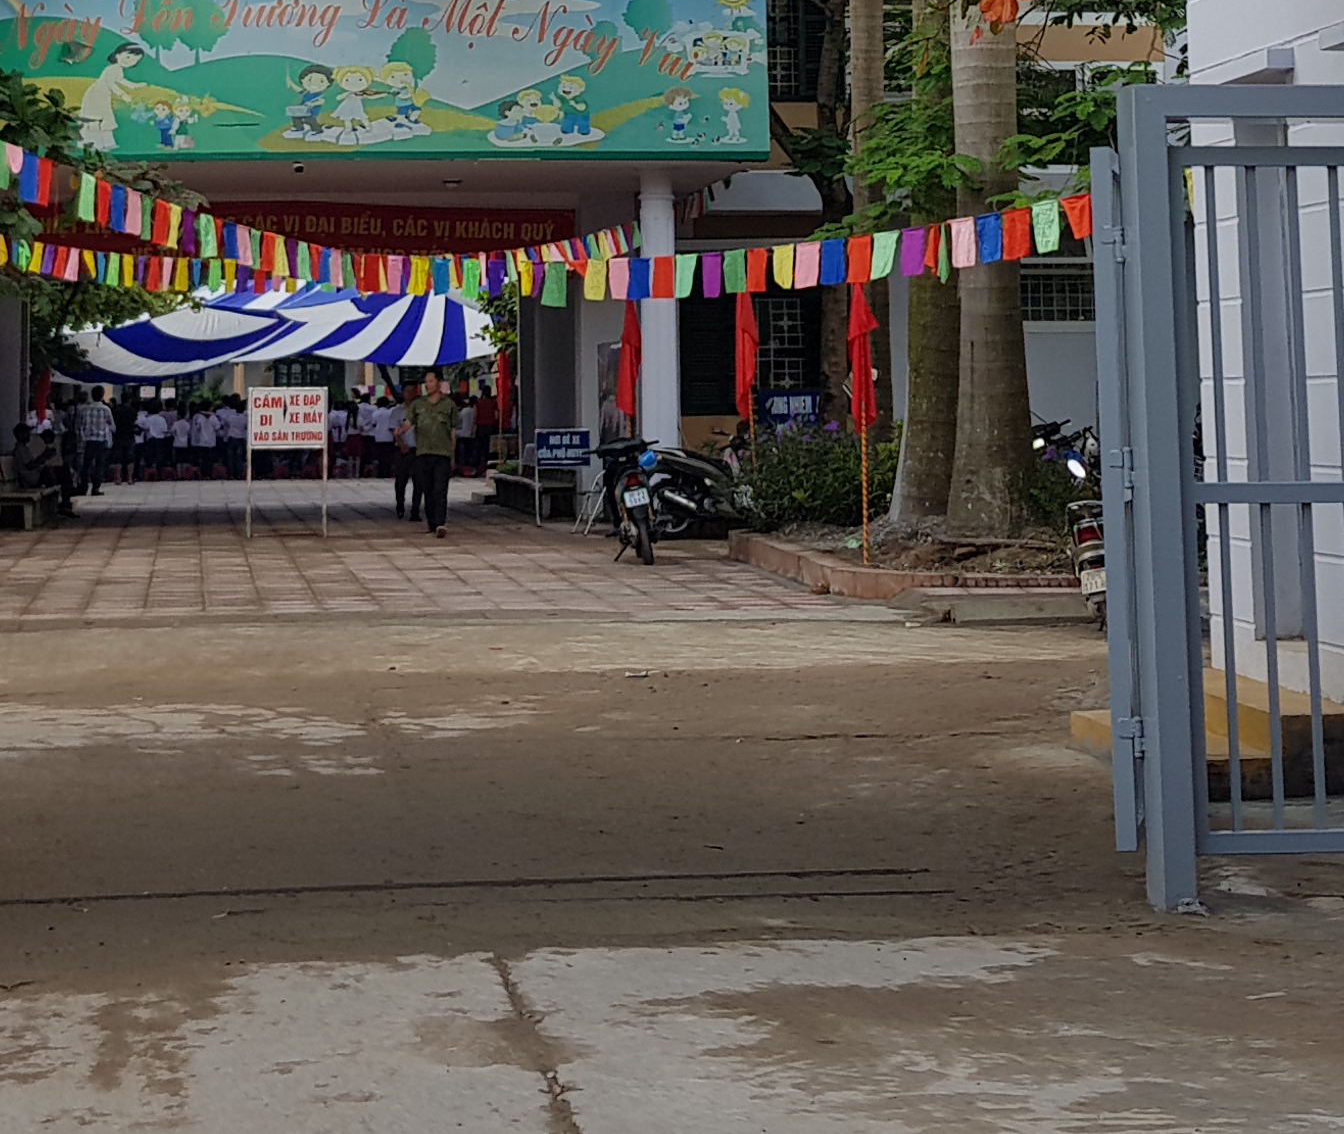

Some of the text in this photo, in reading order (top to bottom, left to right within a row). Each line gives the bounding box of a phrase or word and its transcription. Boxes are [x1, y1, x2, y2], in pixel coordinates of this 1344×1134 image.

[512, 1, 619, 75] Ngày
[637, 26, 701, 82] Vui
[284, 214, 300, 235] VỊ
[305, 215, 334, 235] ĐẠI
[340, 212, 386, 238] BIỂU,
[392, 215, 429, 237] CÁC
[434, 221, 449, 241] VỊ
[455, 218, 514, 240] KHÁCH
[521, 219, 556, 242] QUÝ
[254, 392, 321, 409] CẤM XE ĐẠP
[260, 410, 323, 426] ĐI XE MÁY
